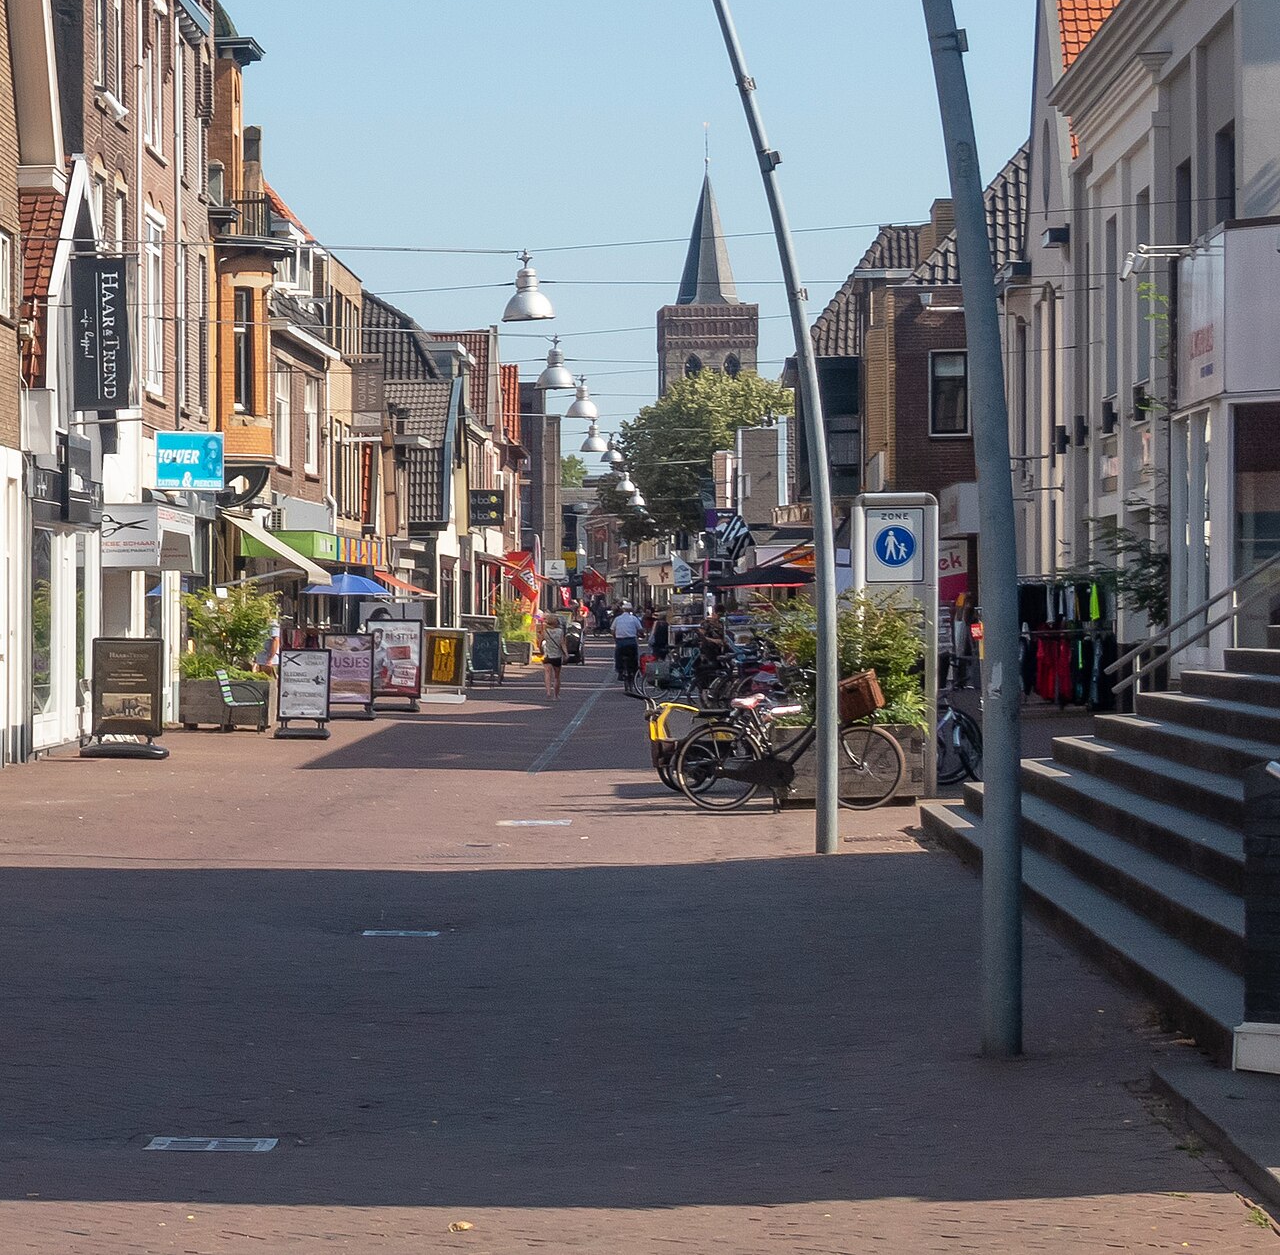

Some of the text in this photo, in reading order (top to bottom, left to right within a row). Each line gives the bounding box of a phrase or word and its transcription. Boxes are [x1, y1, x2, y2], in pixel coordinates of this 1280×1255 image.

[101, 271, 120, 399] HAAR & TREND
[158, 449, 200, 464] TOWER
[181, 471, 193, 488] &
[880, 512, 909, 520] ZONE
[938, 551, 962, 569] ek
[331, 656, 370, 668] USJES
